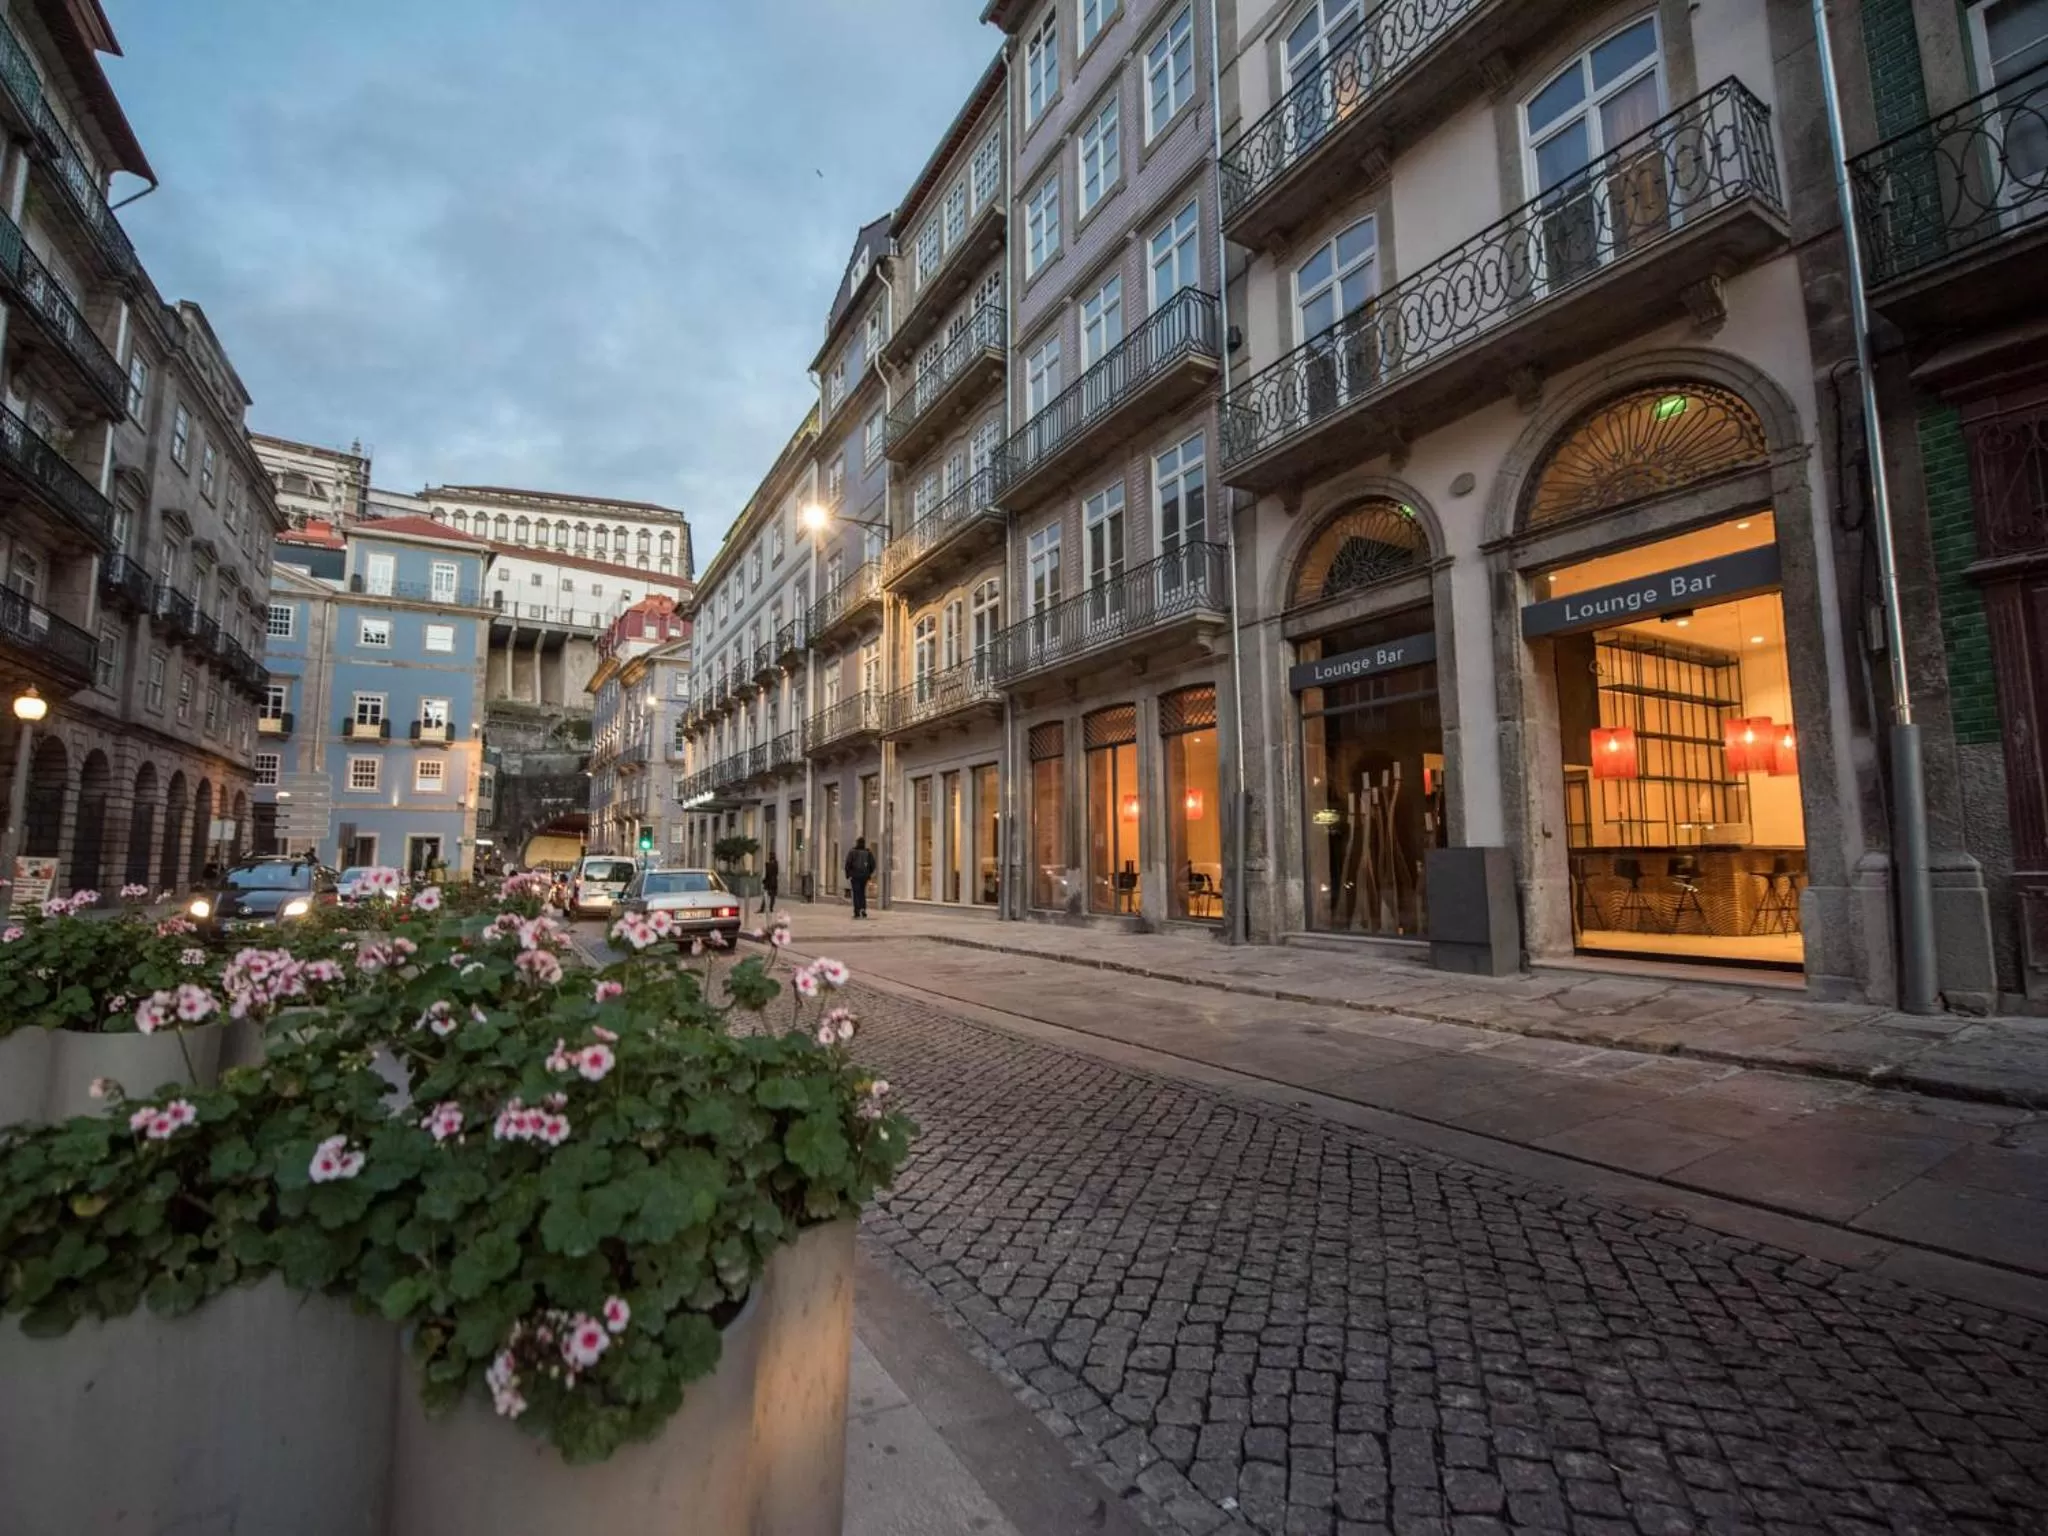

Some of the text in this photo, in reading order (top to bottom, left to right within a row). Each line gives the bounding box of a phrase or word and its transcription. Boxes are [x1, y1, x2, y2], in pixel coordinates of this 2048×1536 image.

[1565, 573, 1717, 621] Lounge Bar
[1314, 648, 1405, 680] Lounge Bar
